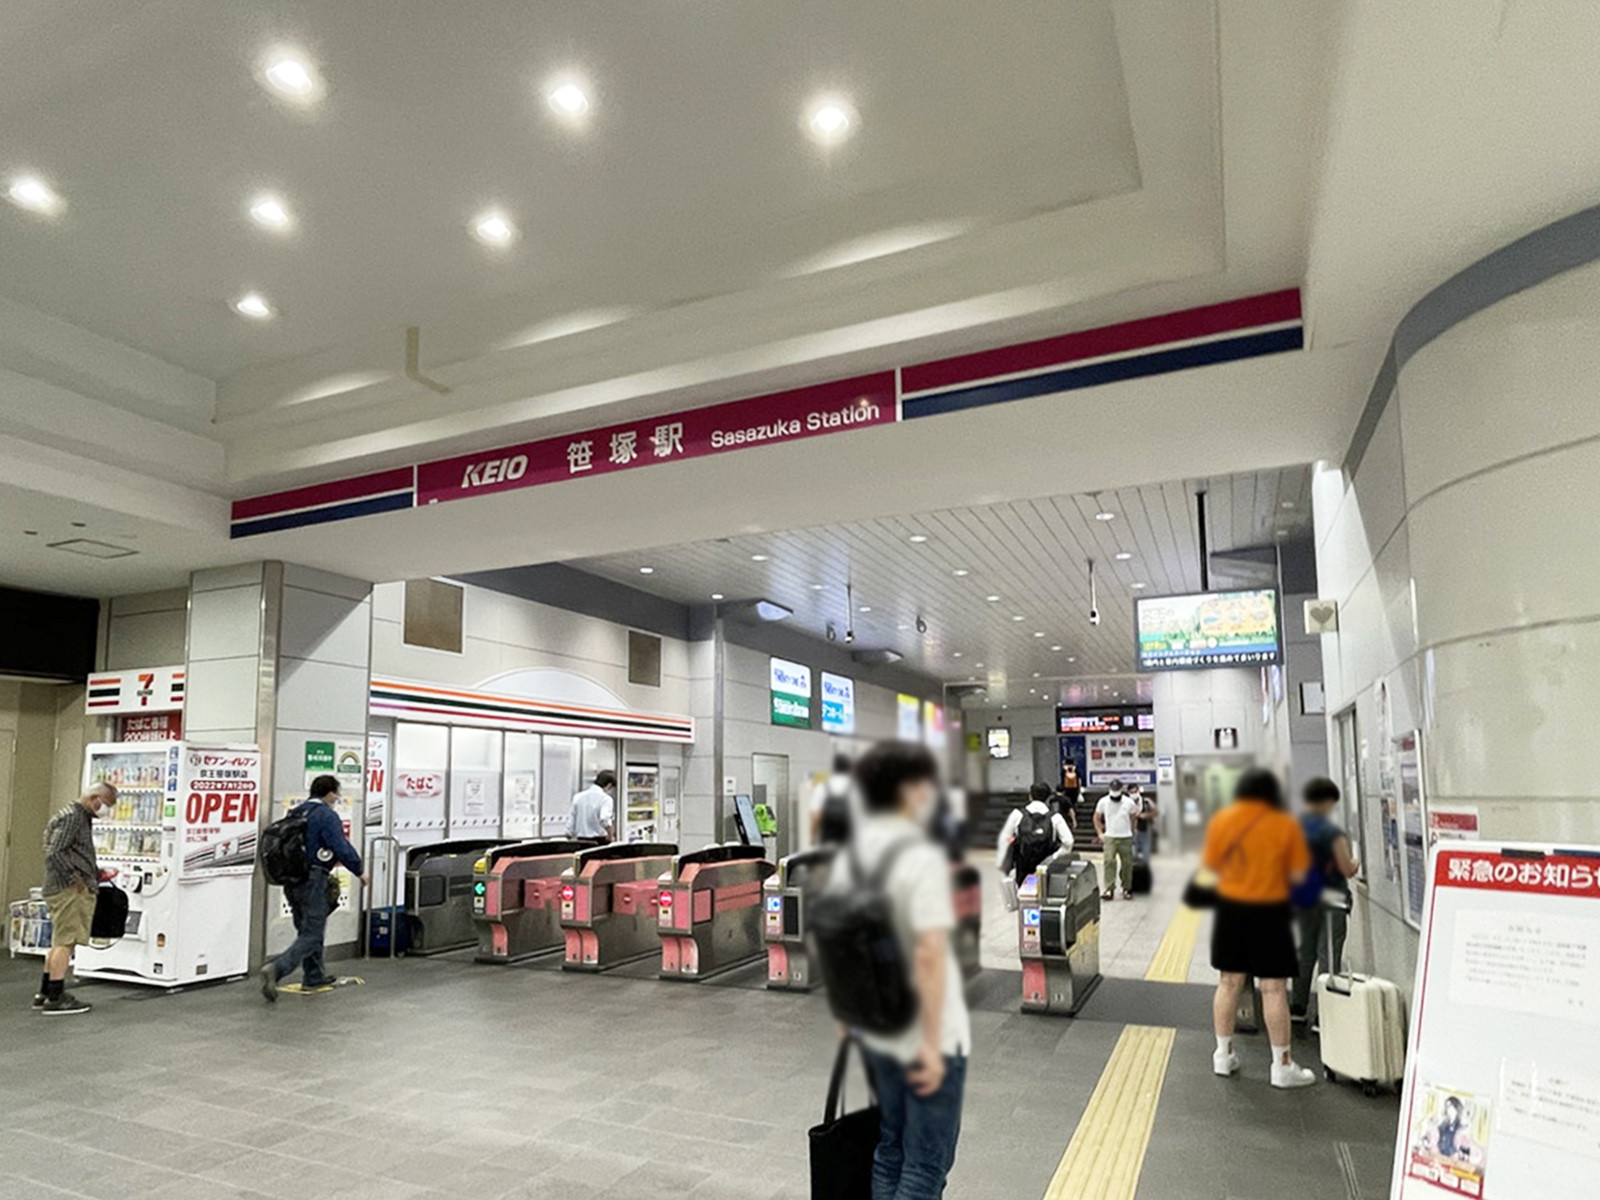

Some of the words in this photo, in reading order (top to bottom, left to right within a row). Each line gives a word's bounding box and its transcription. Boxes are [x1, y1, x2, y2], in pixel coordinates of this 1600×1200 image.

[711, 419, 801, 448] Sasazuka
[806, 404, 880, 431] Station
[567, 422, 684, 474] 笹塚駅
[461, 454, 528, 489] KEIO
[406, 777, 434, 790] たばこ
[185, 792, 258, 824] OPEN
